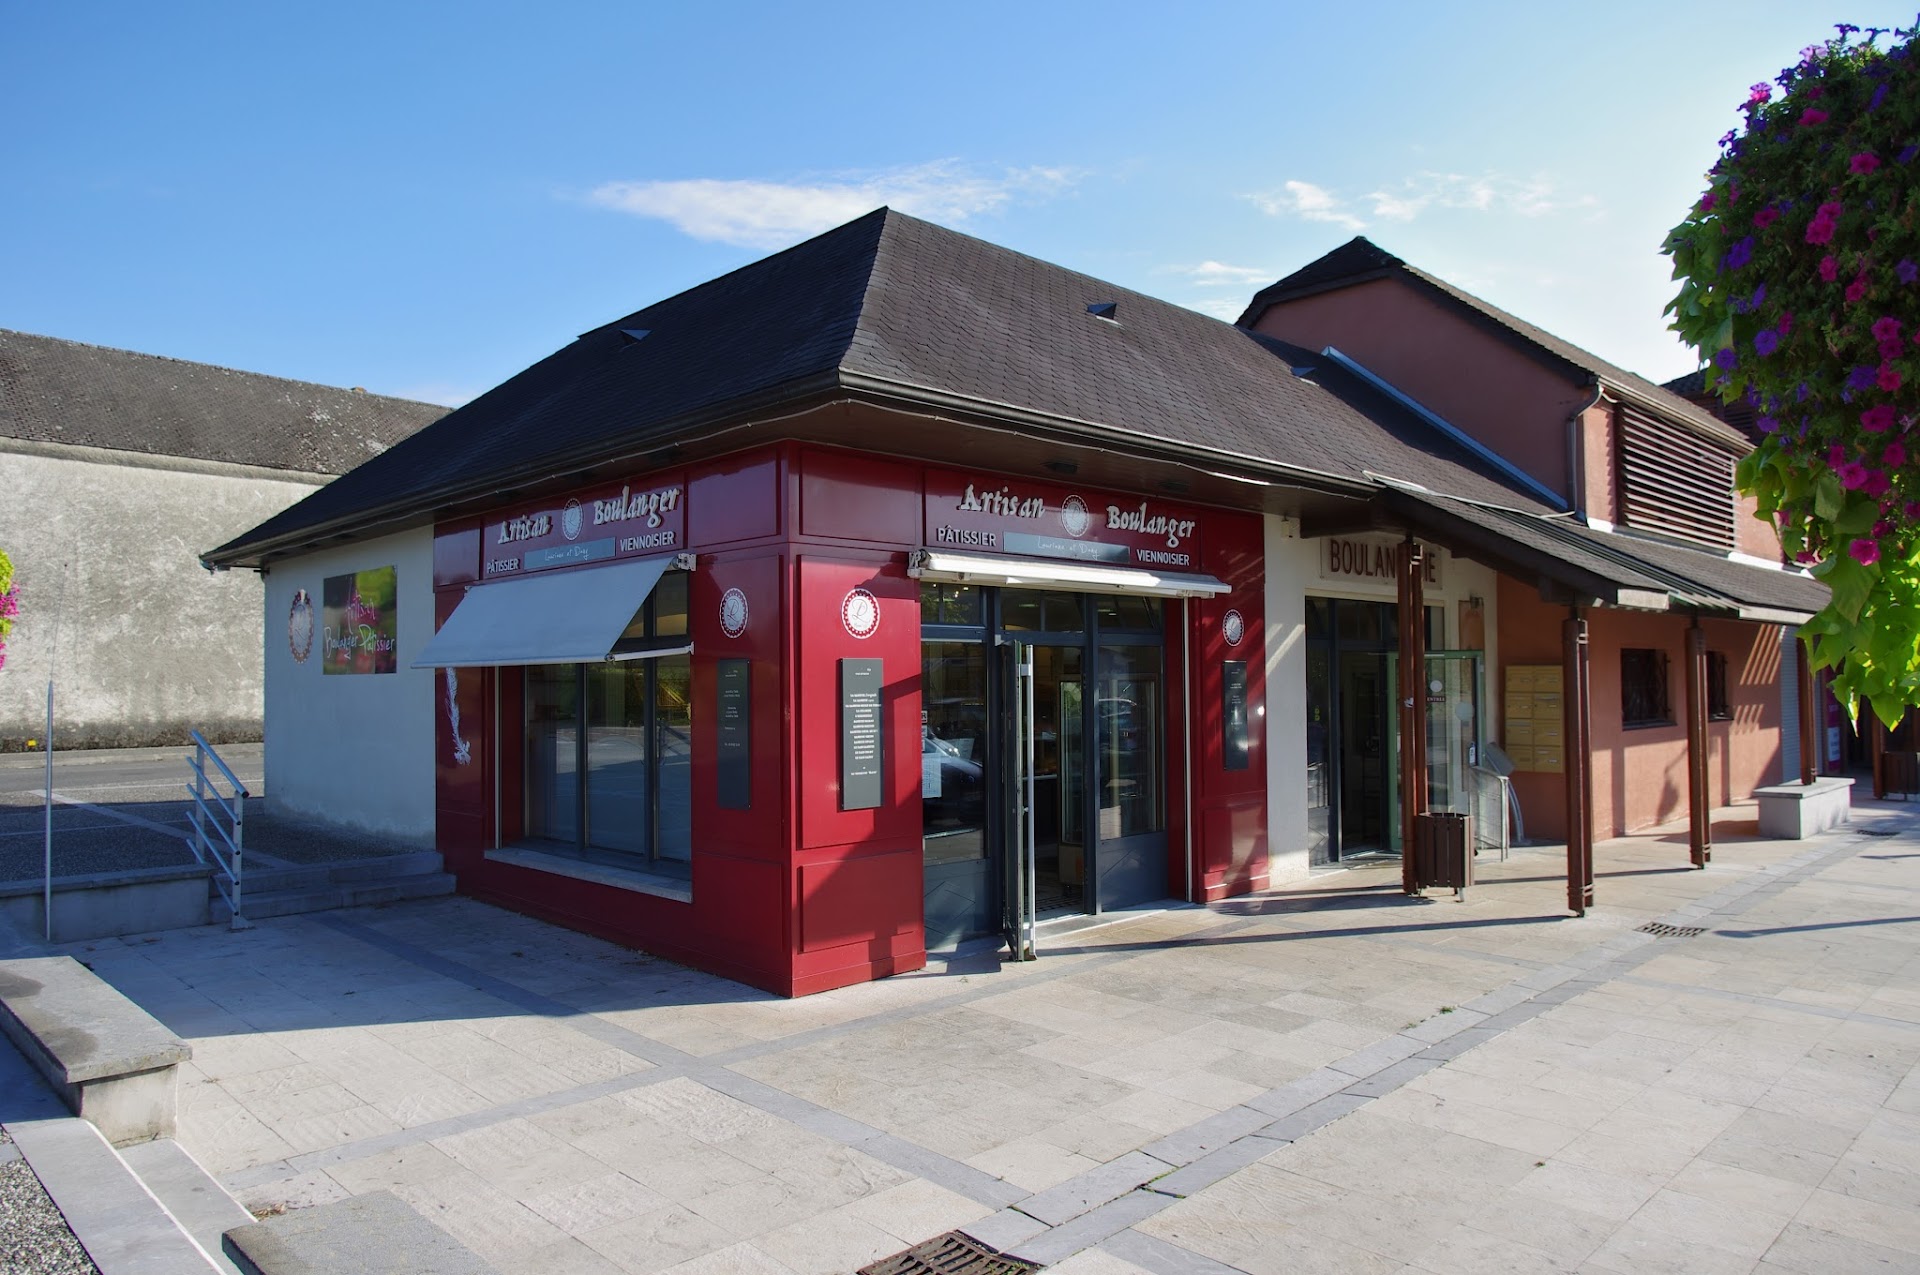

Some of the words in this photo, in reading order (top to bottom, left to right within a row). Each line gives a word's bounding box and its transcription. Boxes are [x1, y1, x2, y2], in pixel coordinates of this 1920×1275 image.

[498, 515, 550, 544] Artisan
[593, 485, 680, 528] Boulanger
[960, 484, 1046, 518] Artisan
[1106, 502, 1196, 548] Boulanger
[619, 531, 675, 552] VIENNOISIER
[936, 525, 997, 547] PÂTISSIER
[486, 557, 520, 575] PÂTISSIER
[1136, 548, 1190, 567] VIENNOISIER
[1330, 540, 1436, 583] BOULANIE
[324, 626, 358, 660] Boulanger
